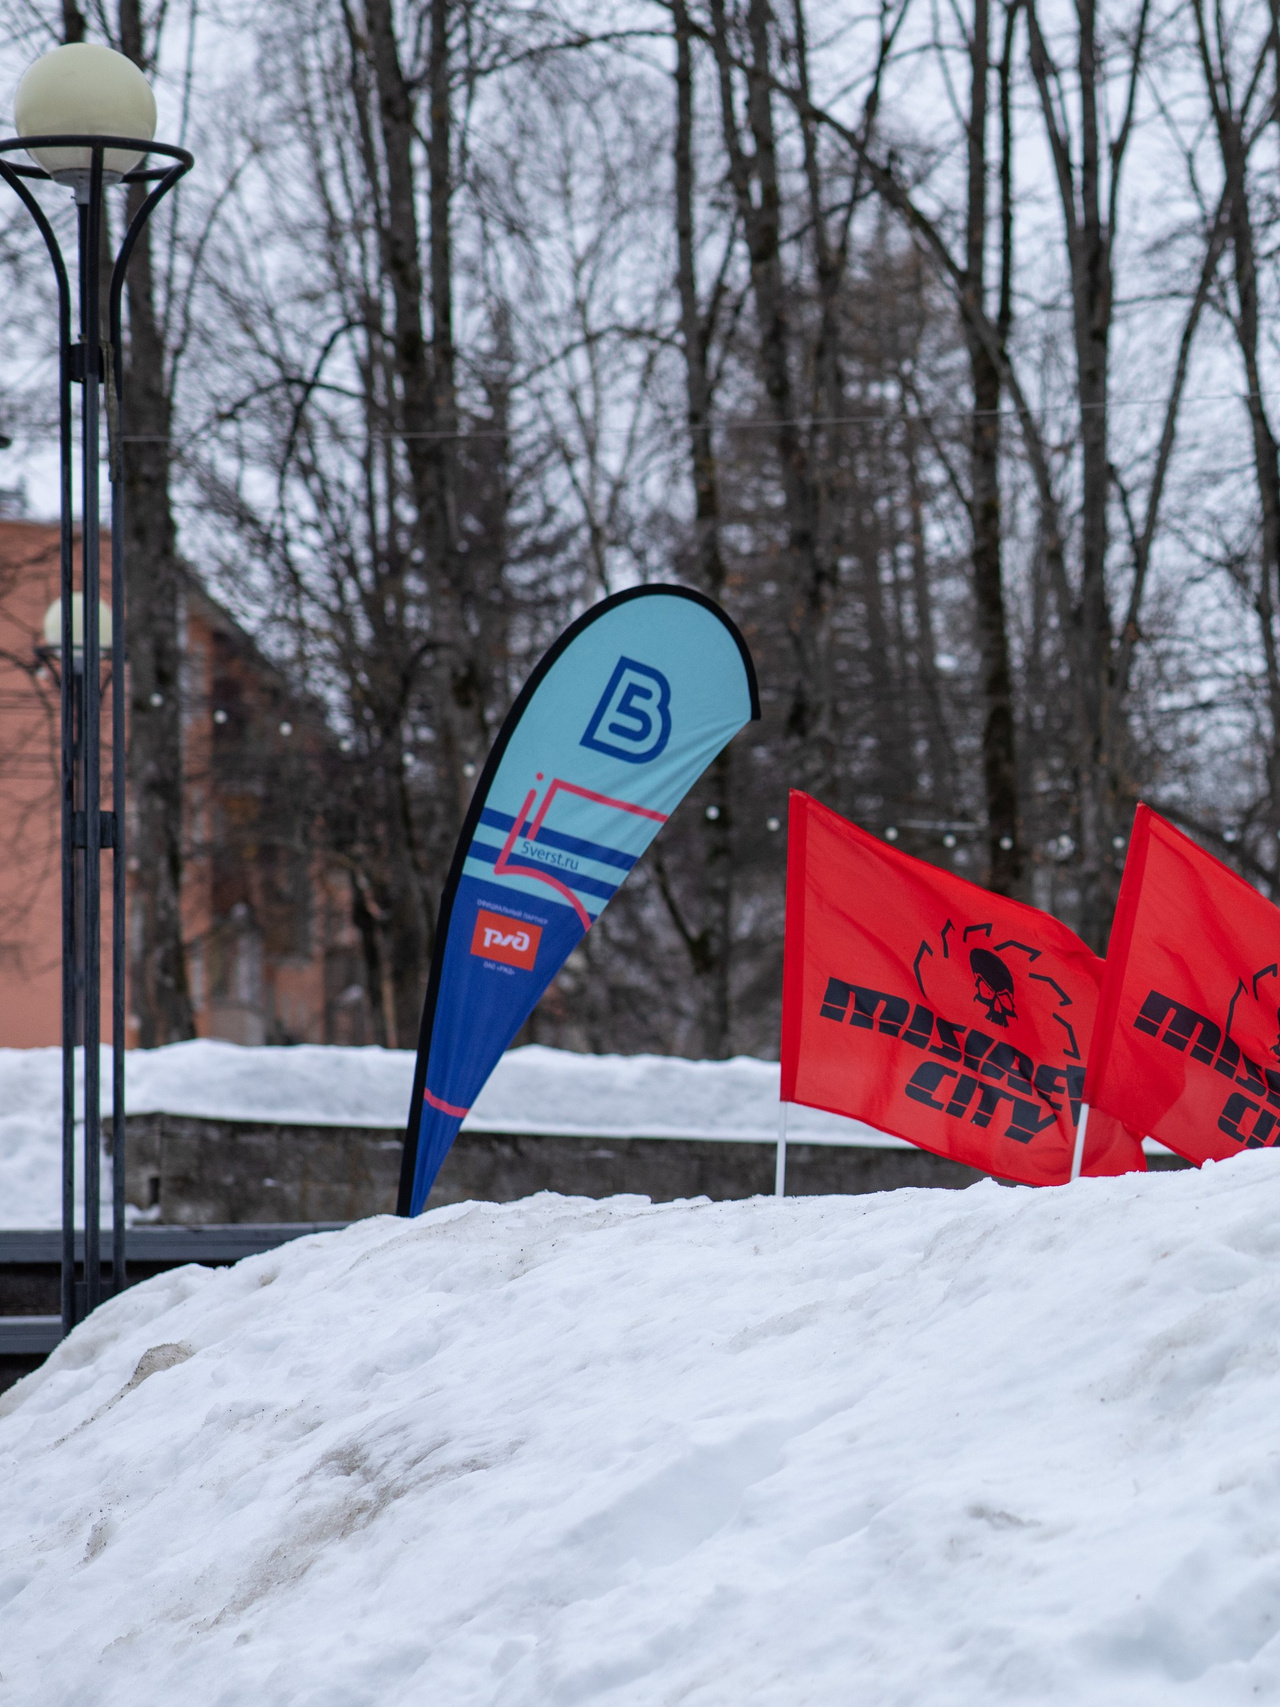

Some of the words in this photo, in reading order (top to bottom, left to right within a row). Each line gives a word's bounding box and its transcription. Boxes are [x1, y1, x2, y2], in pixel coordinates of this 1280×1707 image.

[520, 841, 579, 871] 5verst.ru
[477, 899, 523, 918] ОФИЦИАЛЬНЫЙ
[905, 1061, 1058, 1145] CITY
